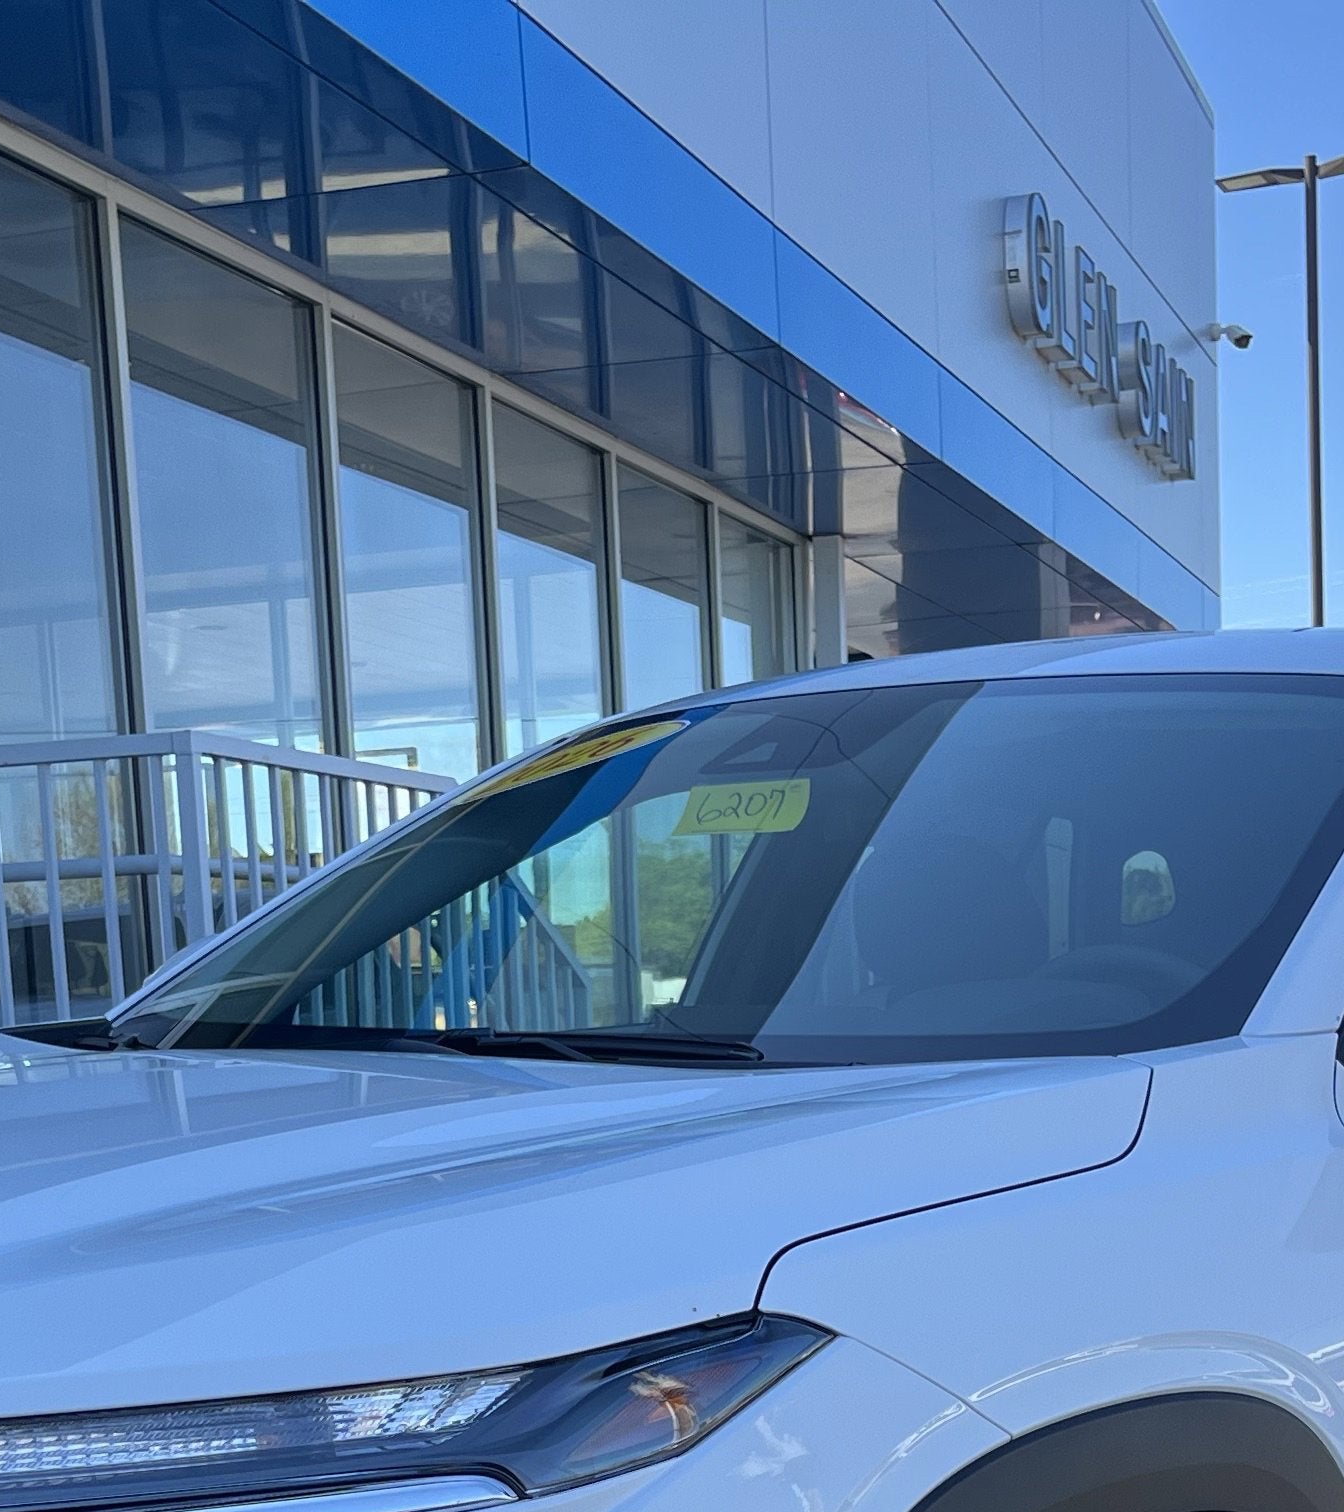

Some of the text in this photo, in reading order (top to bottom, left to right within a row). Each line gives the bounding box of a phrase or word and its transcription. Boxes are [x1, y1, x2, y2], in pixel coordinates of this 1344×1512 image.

[1003, 192, 1195, 480] GLEN SAIN
[696, 789, 785, 825] 6207
